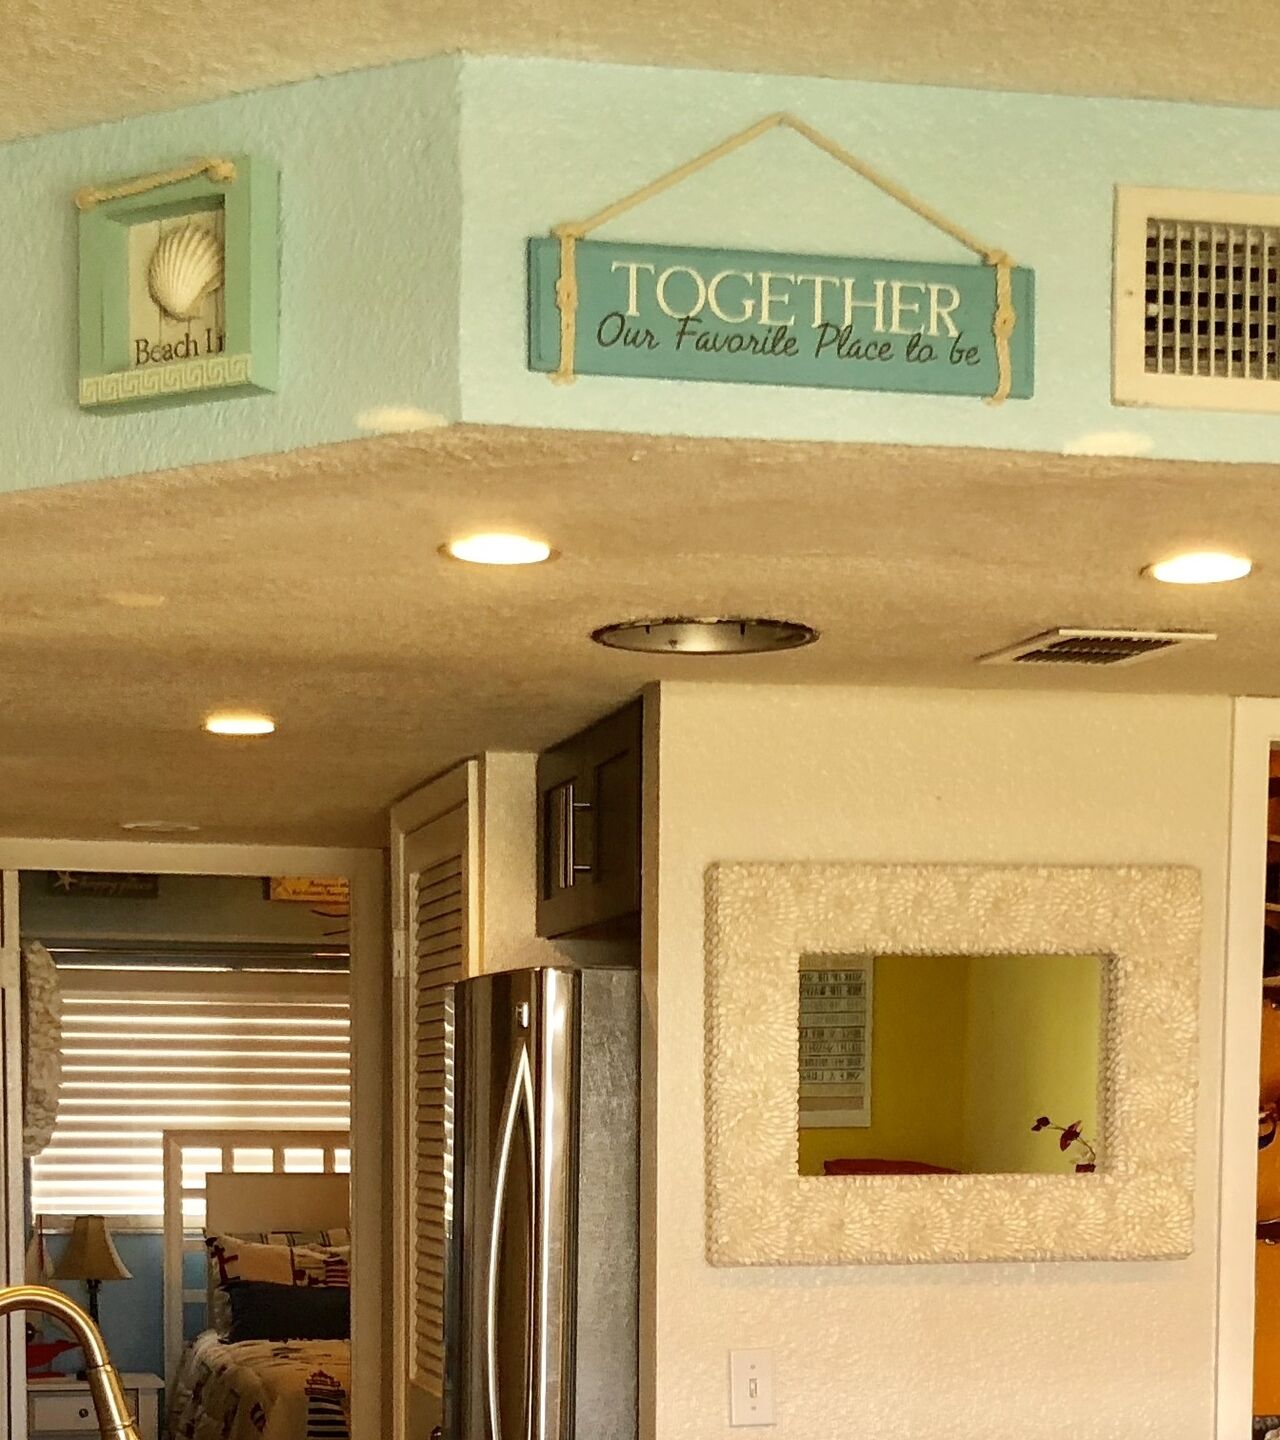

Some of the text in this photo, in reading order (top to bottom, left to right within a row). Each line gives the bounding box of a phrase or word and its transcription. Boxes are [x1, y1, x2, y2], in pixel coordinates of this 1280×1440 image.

[611, 260, 962, 338] TOGETHER
[135, 332, 199, 366] Beach
[596, 311, 982, 367] Our Favorite Place to be
